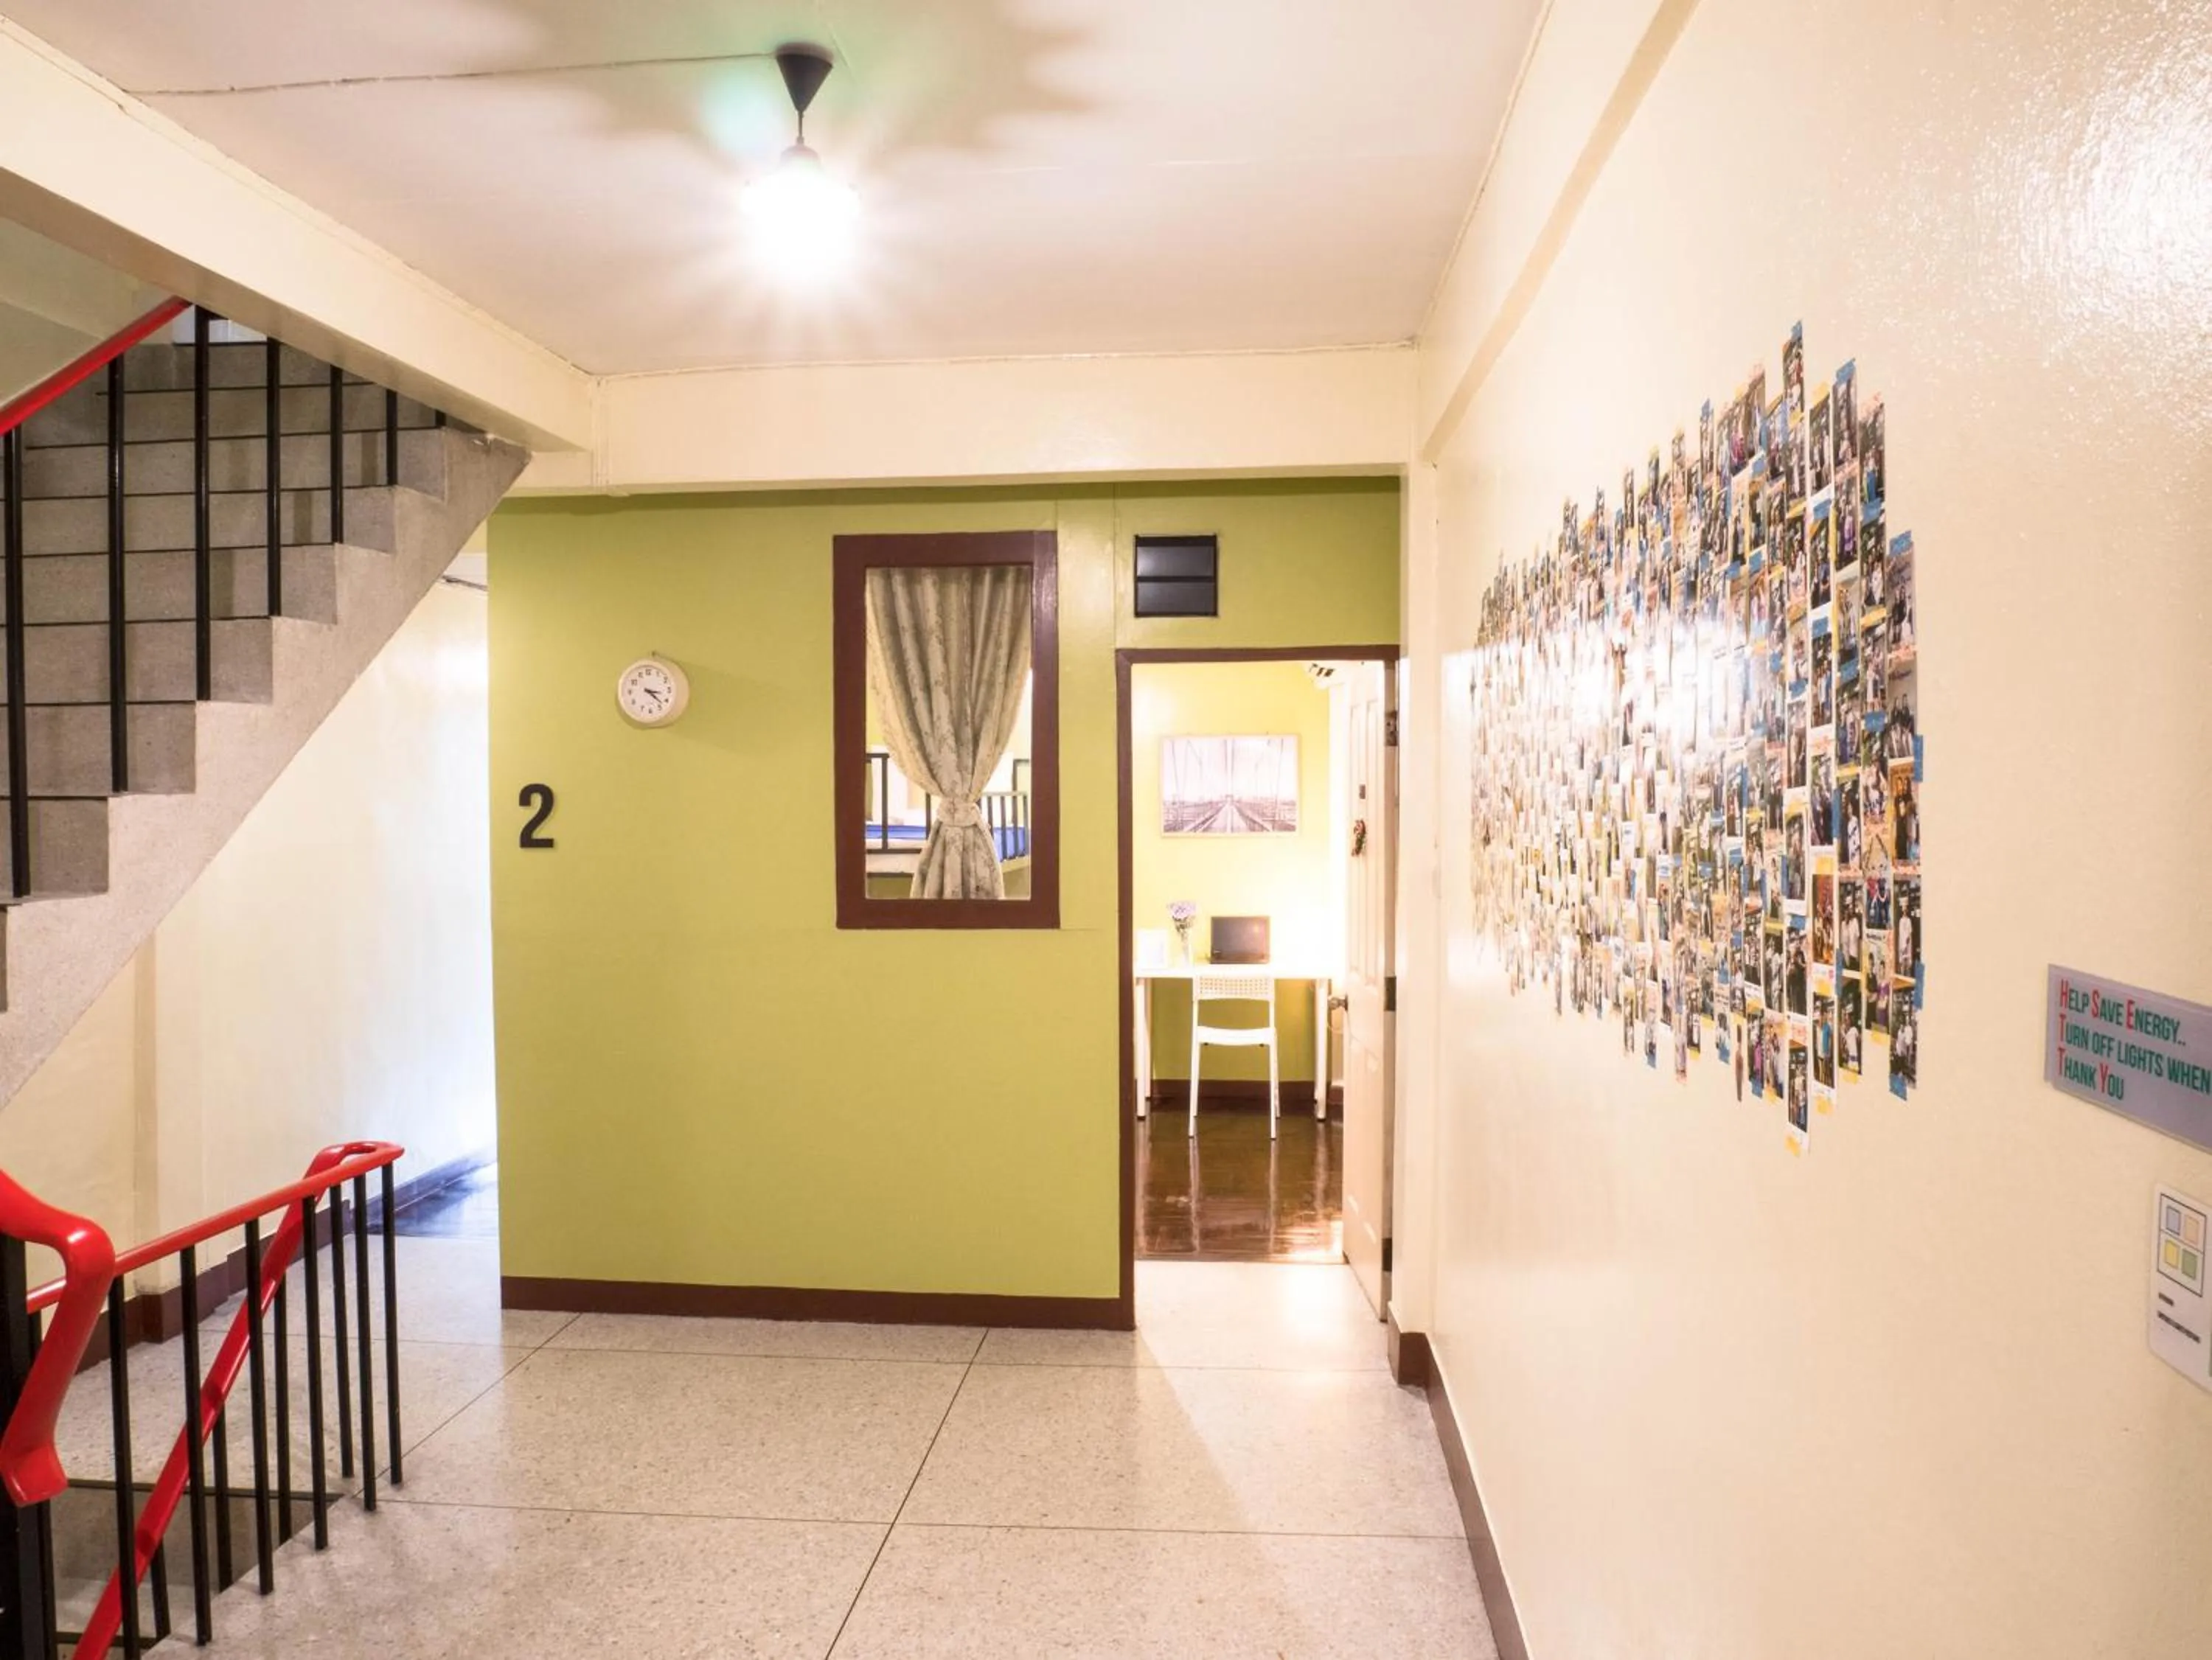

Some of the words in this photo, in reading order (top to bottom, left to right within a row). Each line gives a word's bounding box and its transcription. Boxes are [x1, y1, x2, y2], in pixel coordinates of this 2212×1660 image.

[519, 784, 554, 848] 2
[2091, 989, 2124, 1027] SAVE
[2059, 1014, 2089, 1050] TURN
[2092, 1031, 2115, 1059] OFF
[2117, 1039, 2163, 1078] LIGHTS
[2166, 1056, 2211, 1095] WHEN
[2098, 1062, 2124, 1101] YOU
